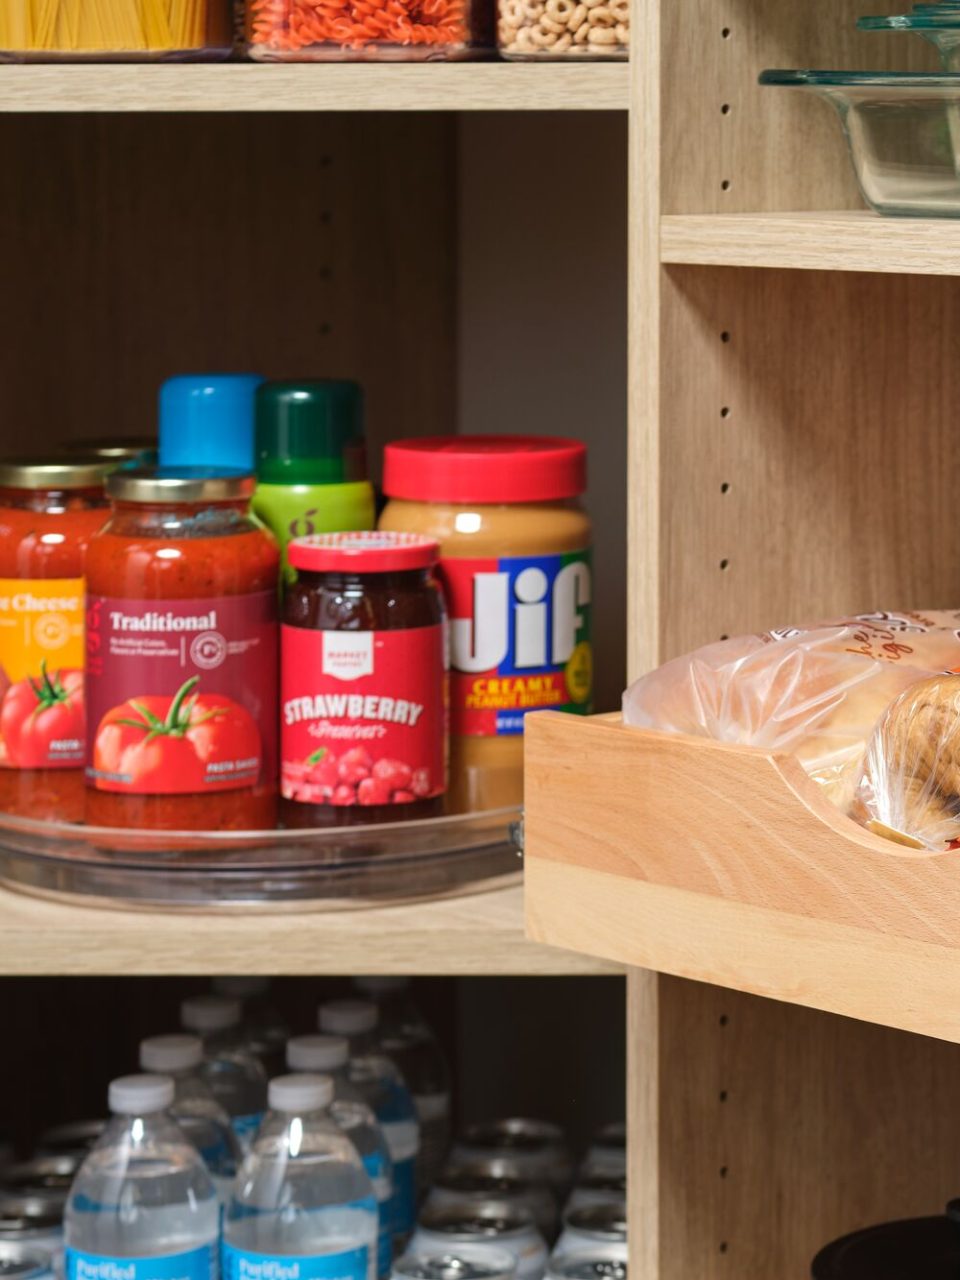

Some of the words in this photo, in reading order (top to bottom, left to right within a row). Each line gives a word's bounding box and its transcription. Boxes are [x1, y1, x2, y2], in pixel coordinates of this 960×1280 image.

[12, 593, 79, 612] Cheese
[110, 610, 216, 631] Traditional
[443, 561, 591, 673] Jif
[472, 676, 554, 698] CREAMY
[284, 693, 424, 727] STRAWBERRY
[77, 1258, 135, 1280] Purified
[239, 1258, 300, 1280] Purified
